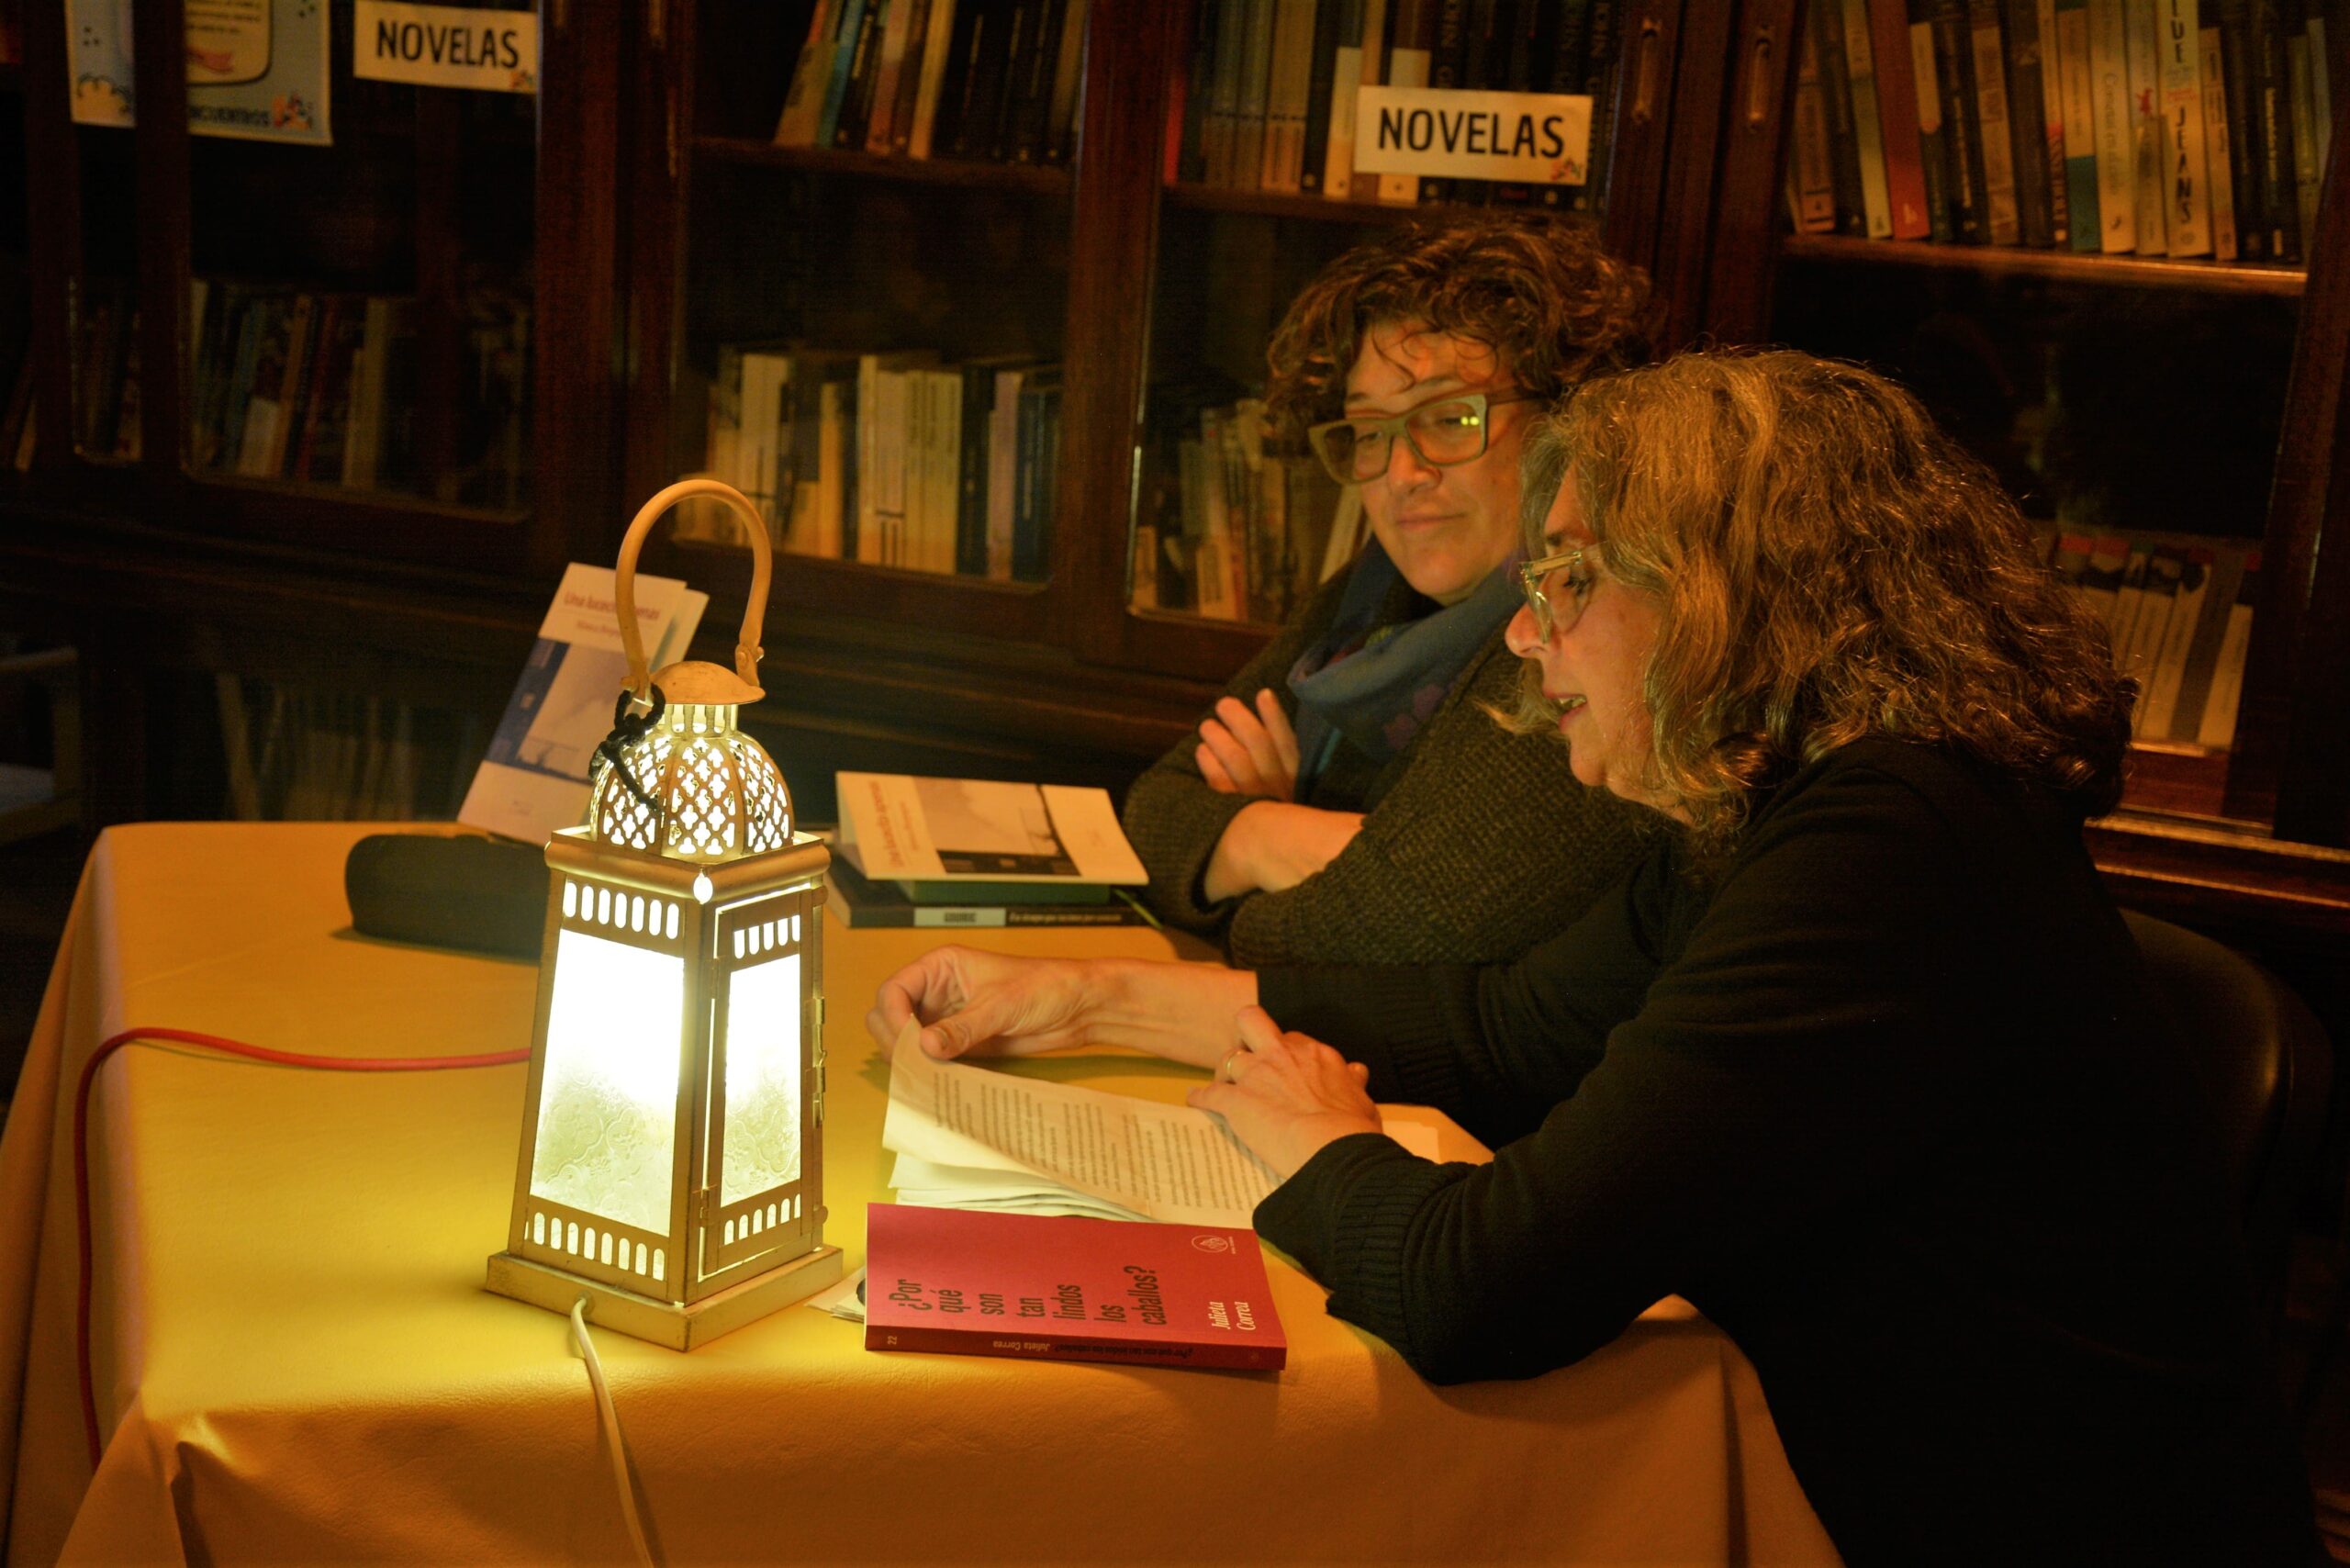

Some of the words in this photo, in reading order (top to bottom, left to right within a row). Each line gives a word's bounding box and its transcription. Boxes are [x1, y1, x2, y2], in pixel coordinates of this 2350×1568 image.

[377, 19, 519, 69] NOVELAS
[188, 105, 271, 127] NCUENTROS
[1379, 107, 1564, 159] NOVELAS
[2176, 106, 2193, 224] JEANS
[888, 1278, 934, 1312] ¿Por
[929, 1289, 971, 1314] qué
[978, 1293, 1005, 1316] son
[1016, 1297, 1046, 1318] tan
[1049, 1284, 1087, 1321] lindos
[1123, 1264, 1168, 1326] caballos?
[1093, 1304, 1127, 1323] los
[1207, 1300, 1231, 1330] Julieta
[1234, 1300, 1257, 1331] Correa
[887, 1335, 898, 1346] 22
[992, 1339, 1022, 1350] Correa
[1023, 1342, 1051, 1352] Julieta
